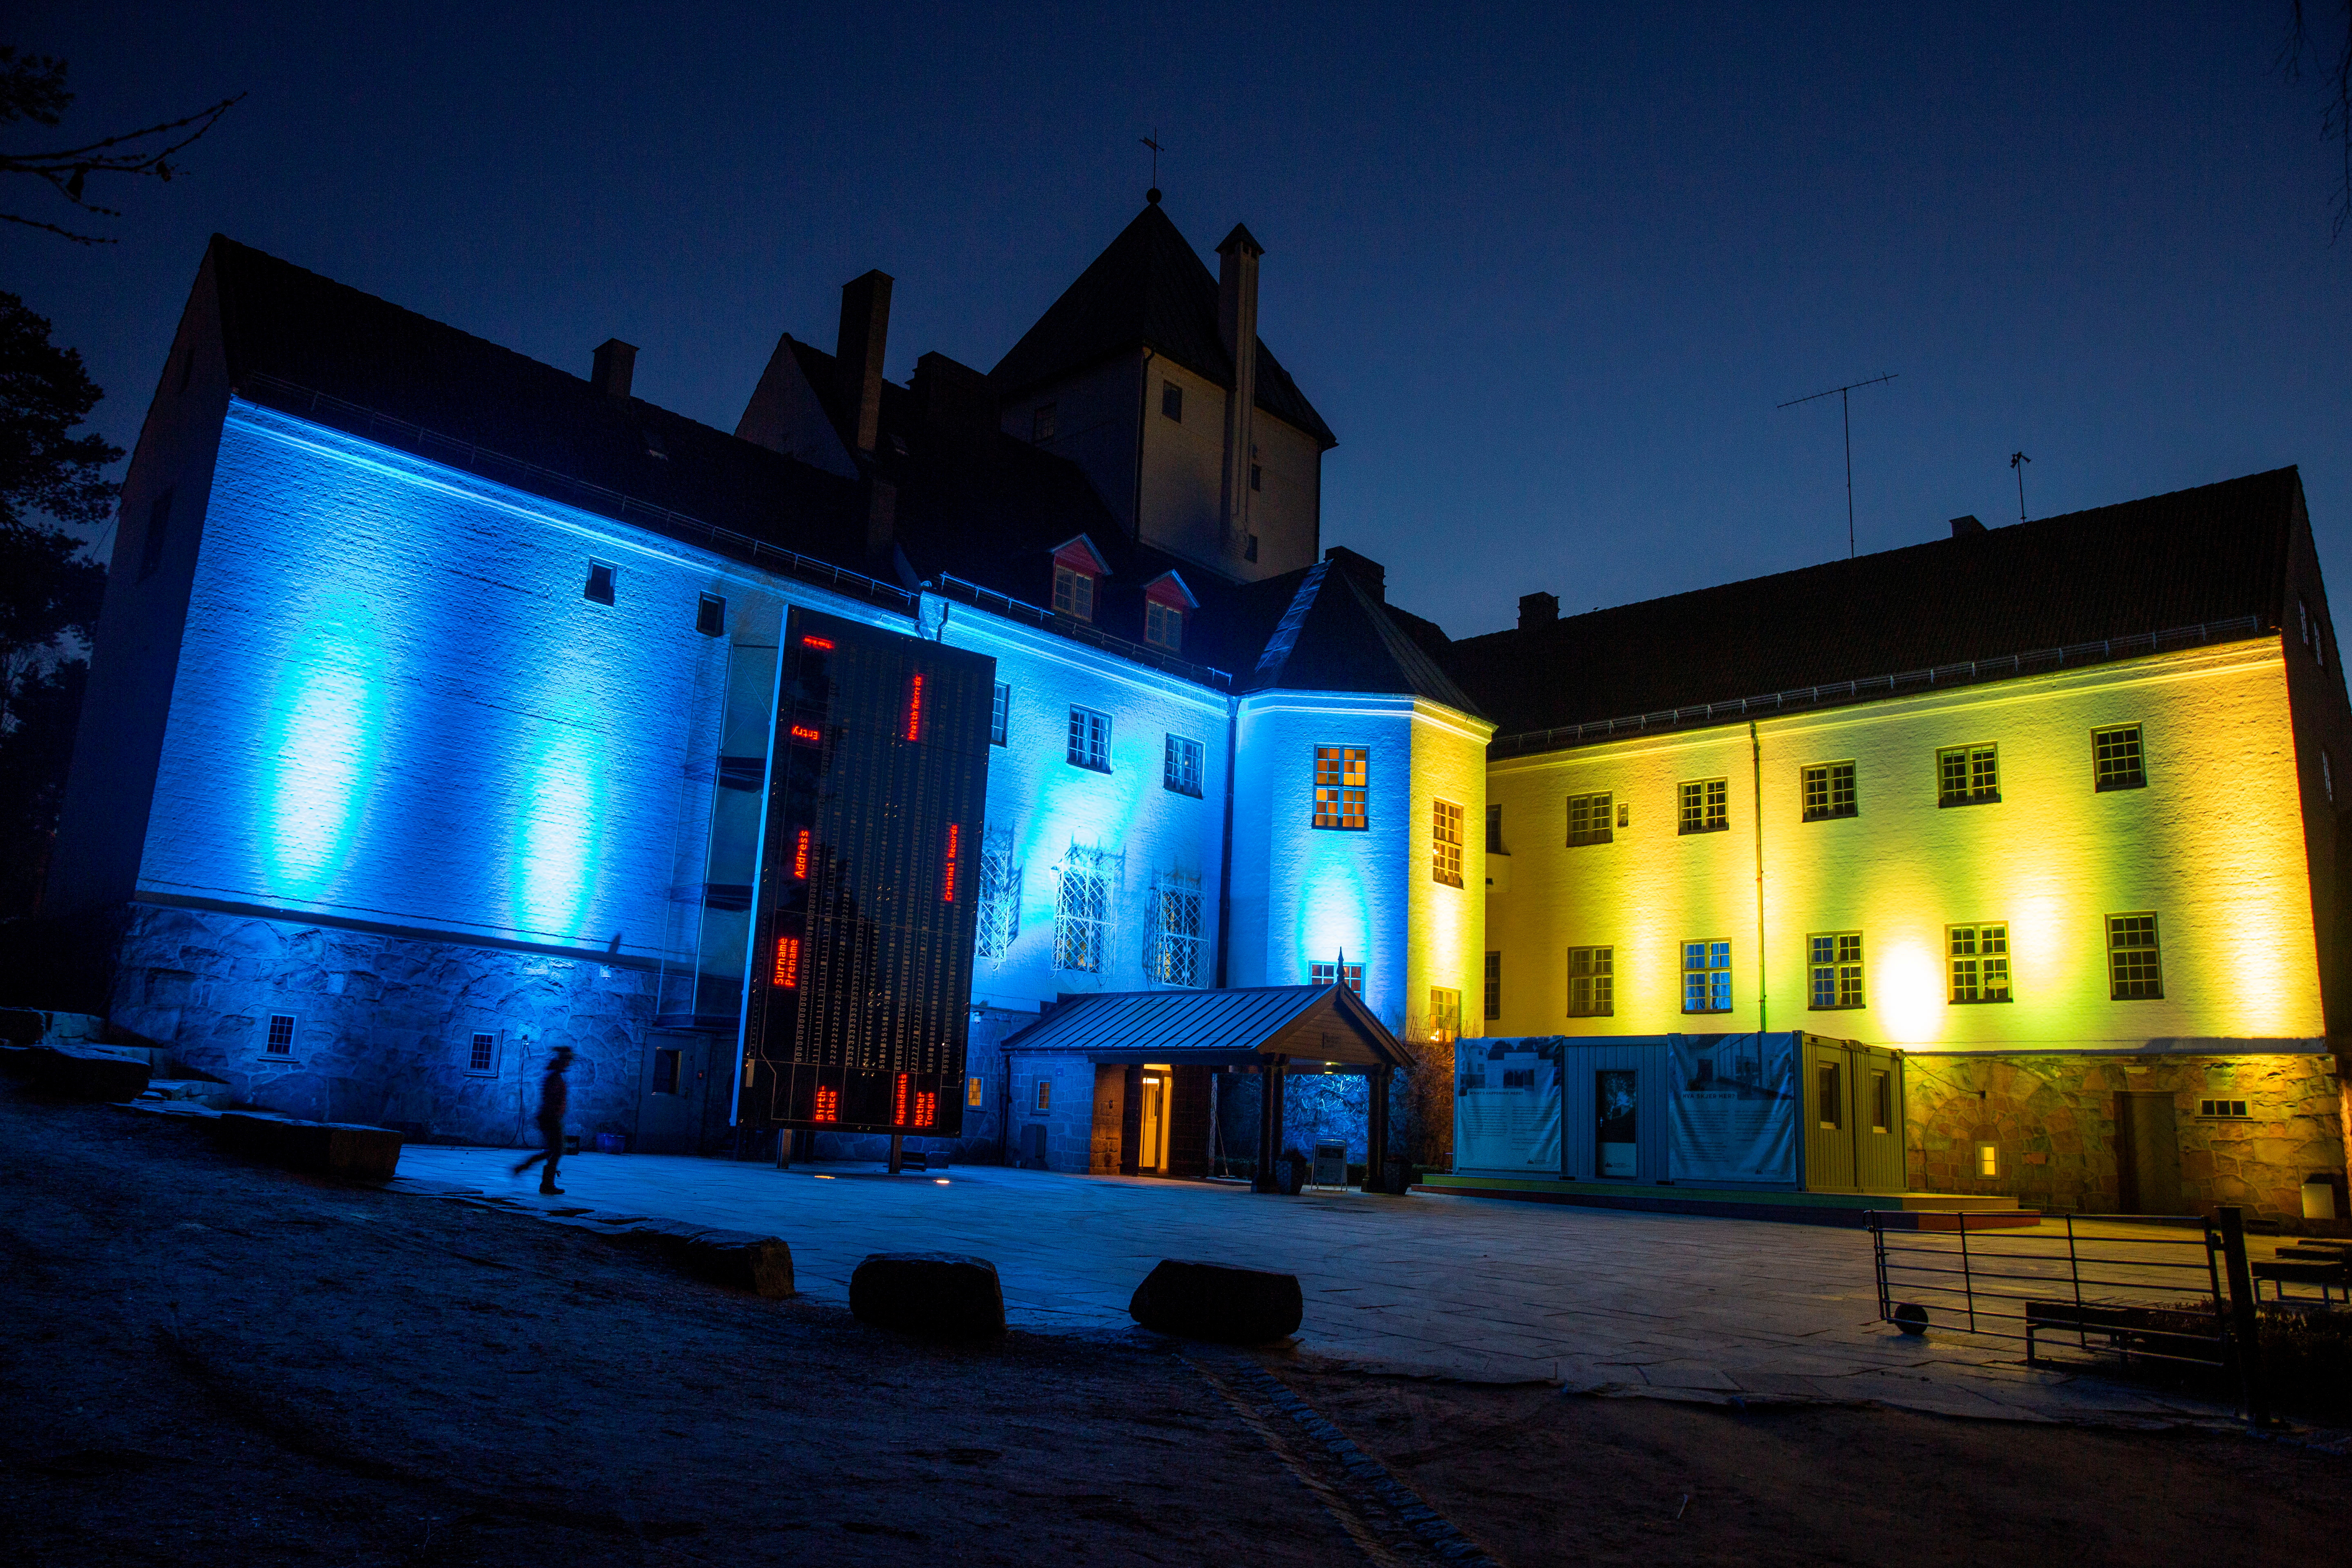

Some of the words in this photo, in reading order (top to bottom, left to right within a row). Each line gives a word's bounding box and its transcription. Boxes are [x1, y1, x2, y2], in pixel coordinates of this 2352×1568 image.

[912, 676, 922, 709] Records
[792, 726, 818, 740] Entry
[909, 710, 919, 740] Health
[795, 831, 808, 878] Address
[948, 824, 958, 858] Records
[945, 862, 954, 901] Criminal
[774, 938, 787, 984] Surname
[816, 1085, 826, 1120] Birth-
[827, 1091, 836, 1120] place
[896, 1074, 907, 1125] Dependents
[915, 1092, 925, 1126] Mother
[924, 1092, 935, 1126] Tongue
